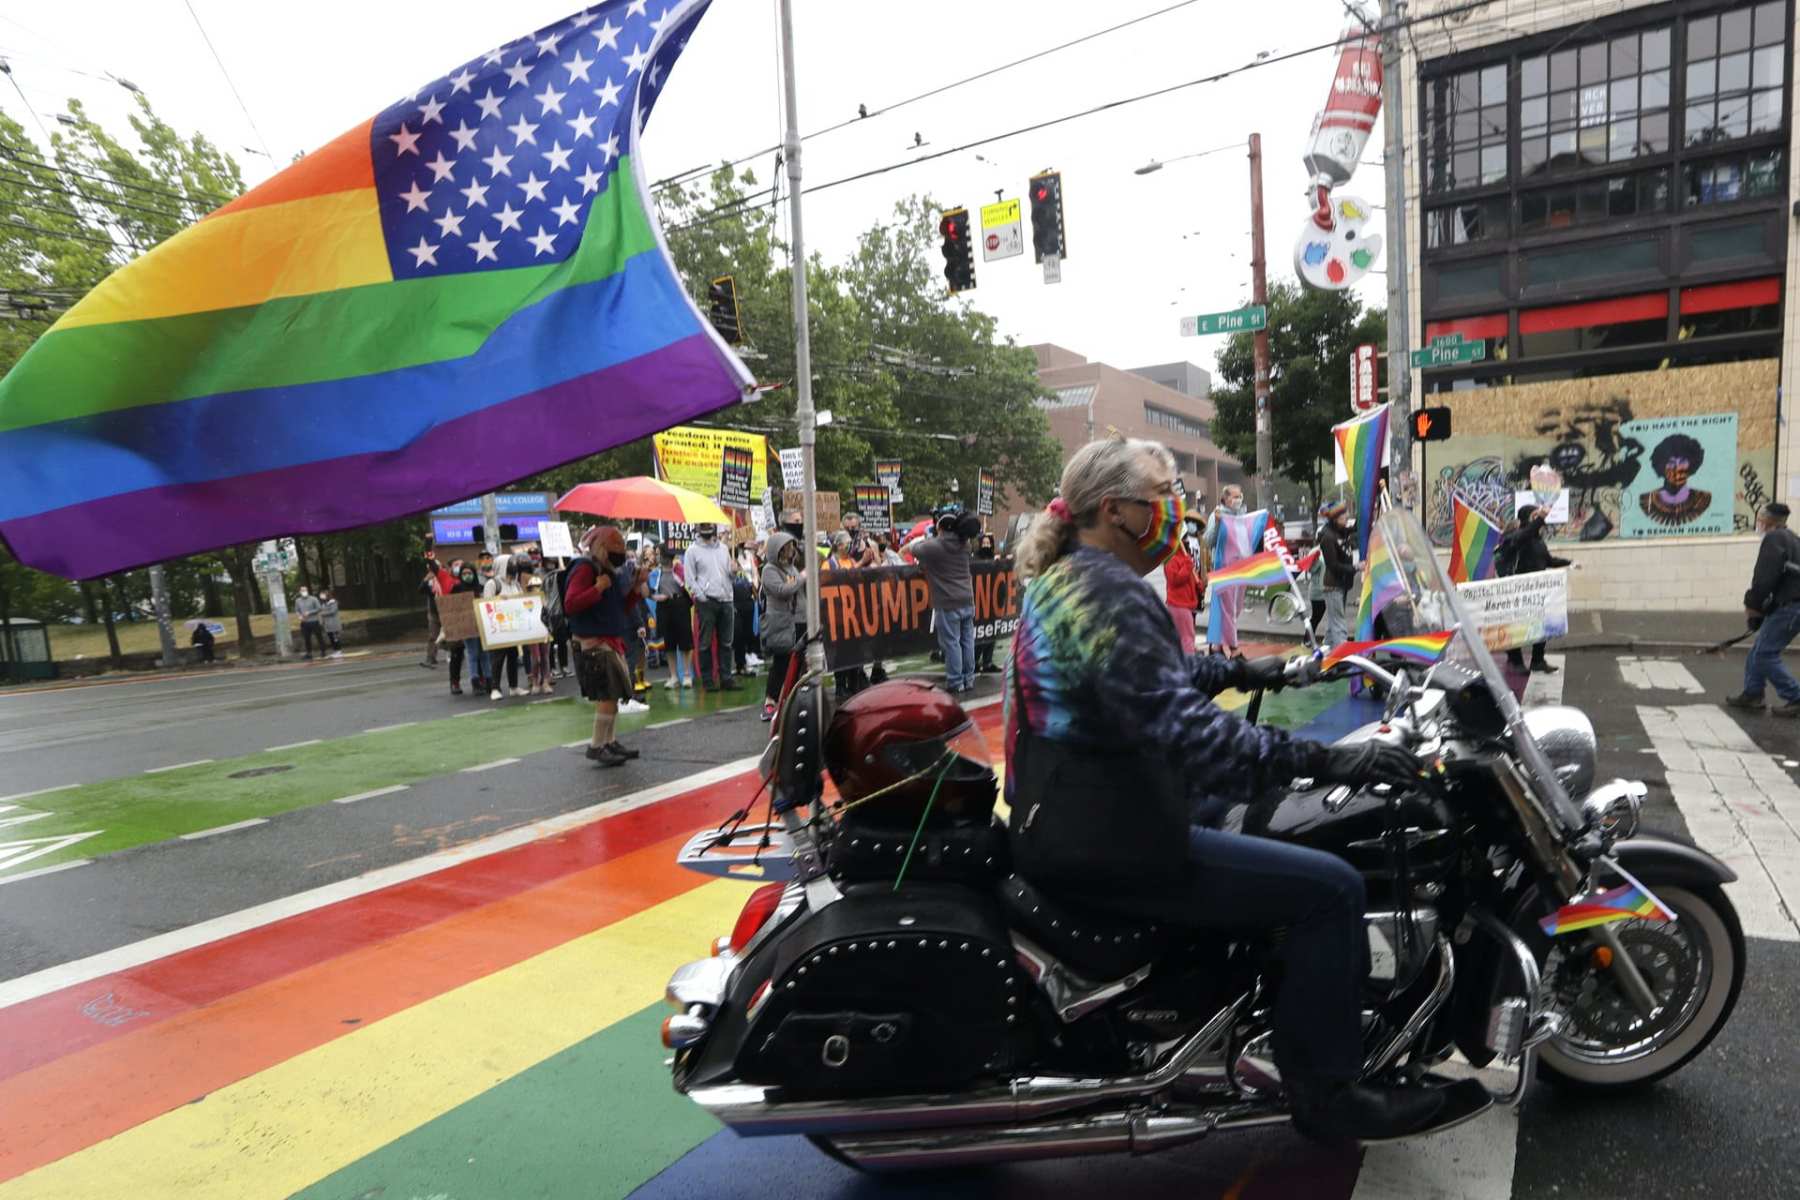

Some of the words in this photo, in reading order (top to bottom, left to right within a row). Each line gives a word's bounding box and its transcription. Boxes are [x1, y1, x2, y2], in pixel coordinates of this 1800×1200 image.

[1218, 315, 1243, 330] Pine
[1431, 344, 1460, 362] Pine
[1652, 422, 1678, 430] HAVE
[1702, 416, 1733, 424] RIGHT
[783, 461, 804, 470] REVO
[1647, 527, 1685, 535] REMAIN
[1688, 525, 1721, 533] HEARD
[820, 577, 930, 642] TRUMP
[1484, 598, 1512, 612] March
